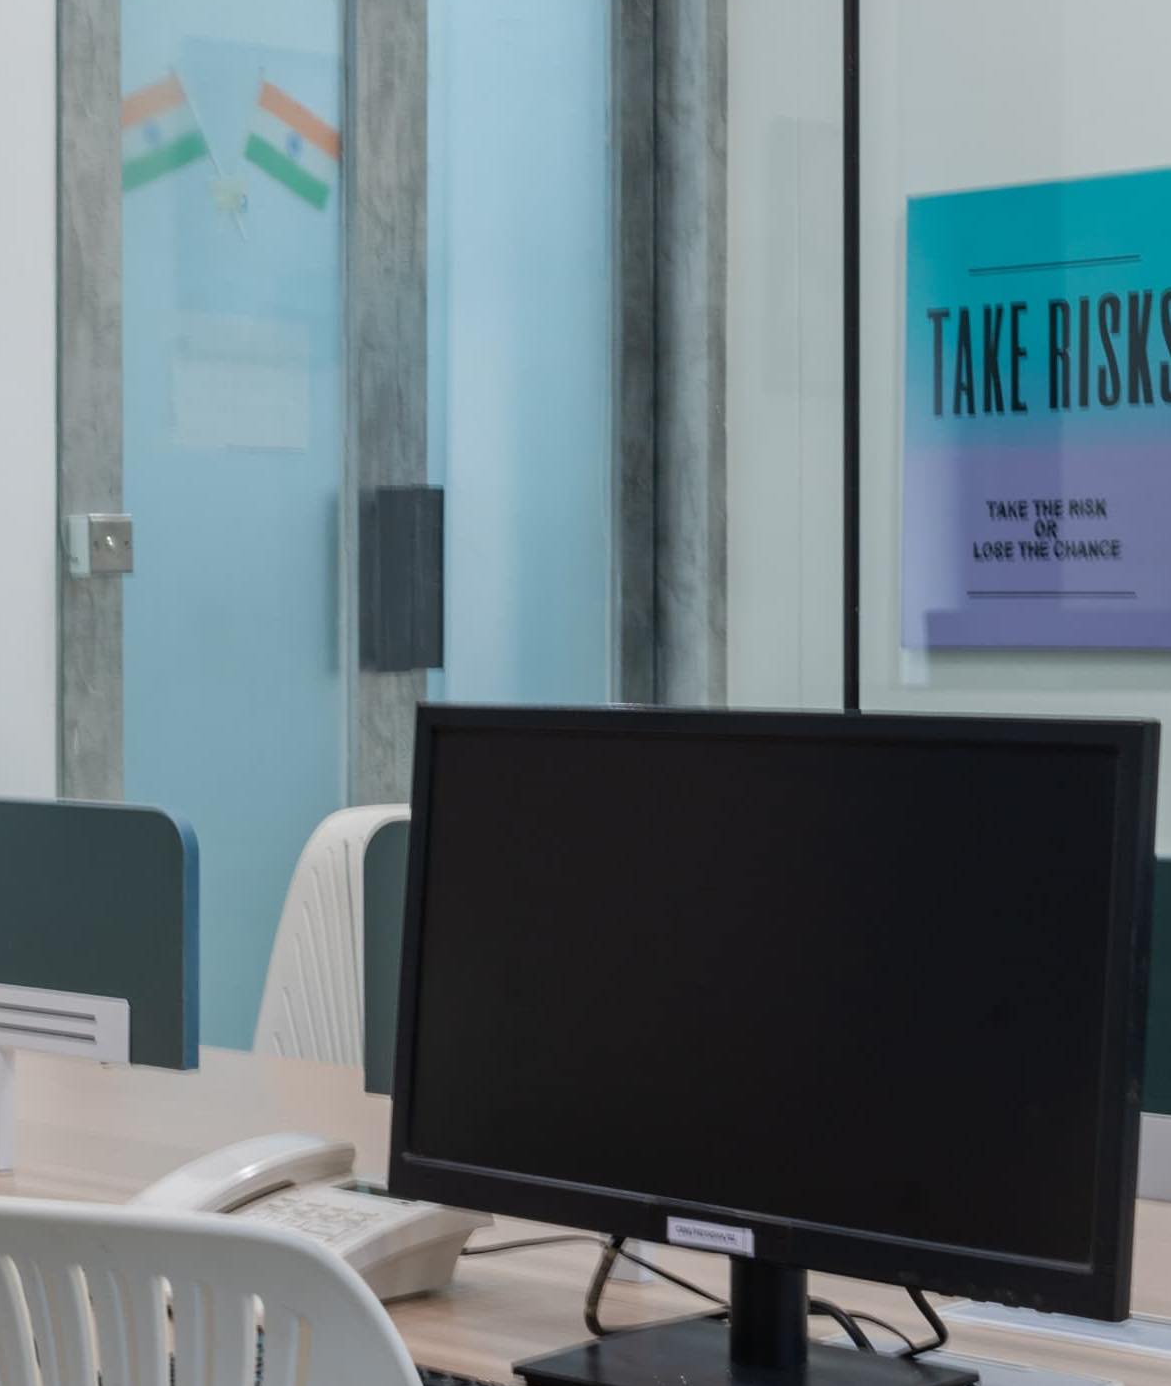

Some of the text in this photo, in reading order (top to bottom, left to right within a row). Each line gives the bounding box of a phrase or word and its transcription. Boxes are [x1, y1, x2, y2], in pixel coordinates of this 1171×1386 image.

[927, 301, 1027, 416] TAKE
[986, 498, 1107, 519] TAKE THE RISK
[1034, 518, 1057, 539] OR
[972, 539, 1122, 561] LOSE THE CHANCE
